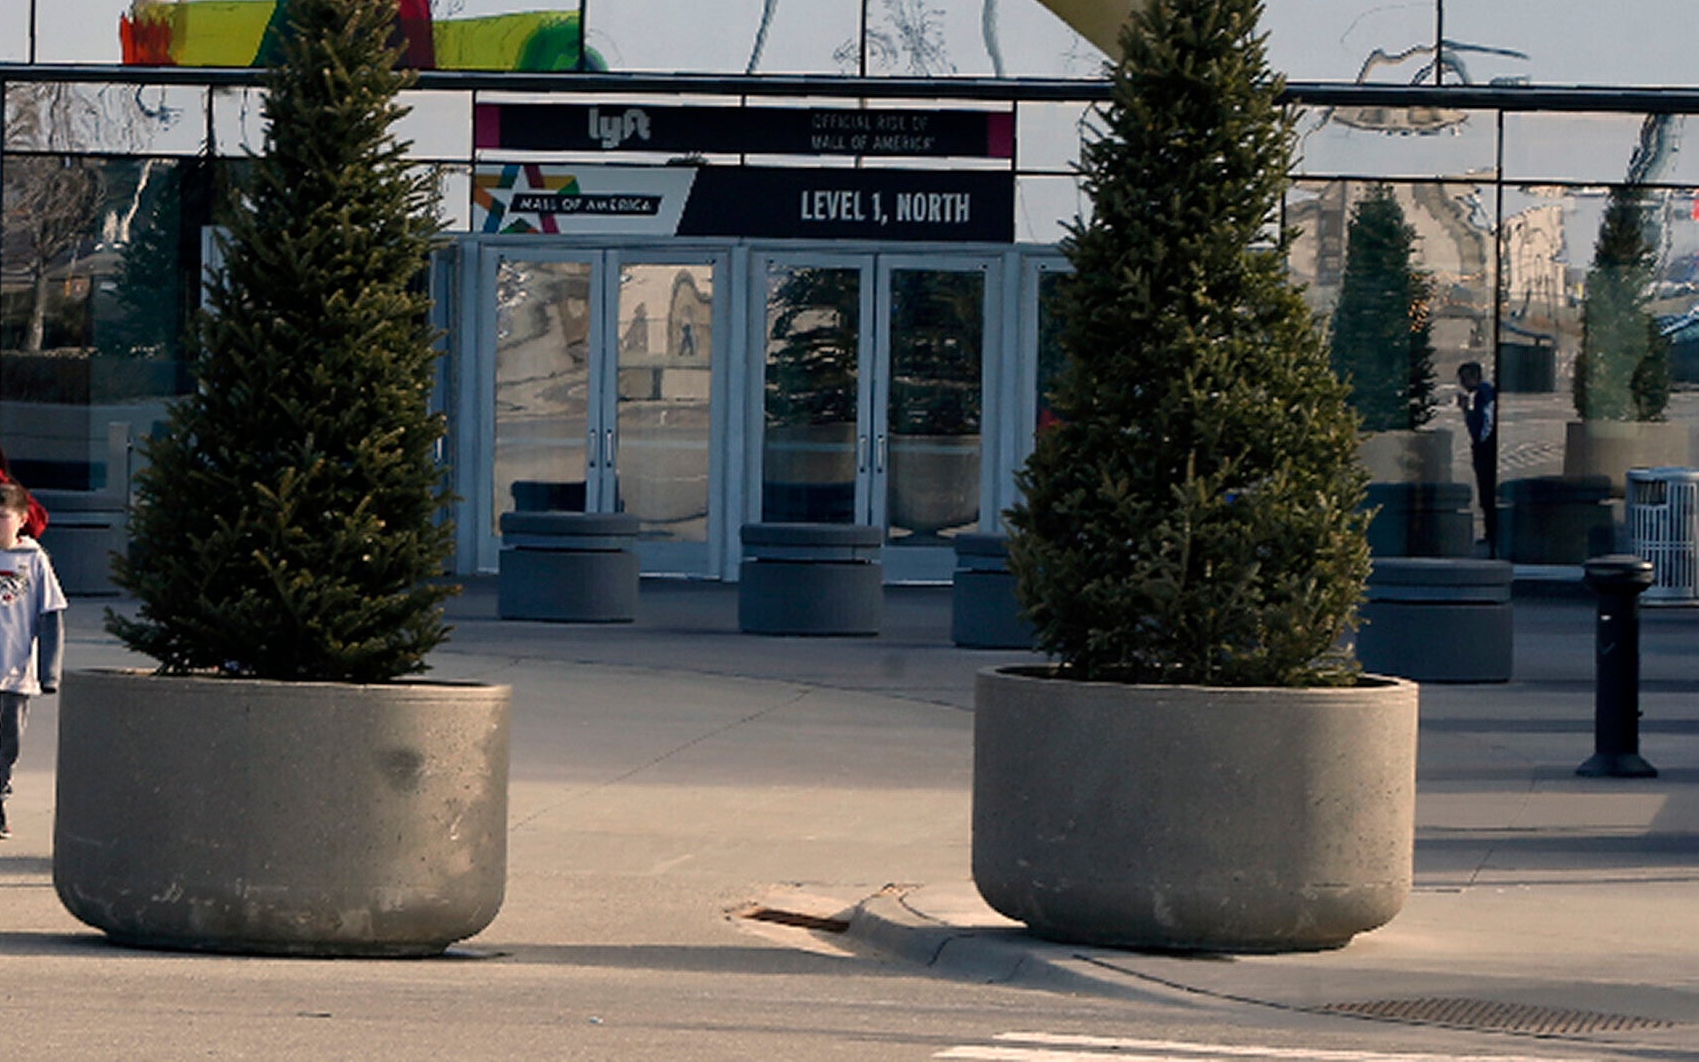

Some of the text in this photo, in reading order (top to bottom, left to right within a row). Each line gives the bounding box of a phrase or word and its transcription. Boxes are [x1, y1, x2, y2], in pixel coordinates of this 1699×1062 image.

[588, 107, 651, 149] lyft
[811, 134, 846, 150] MALL
[850, 135, 869, 151] OF
[519, 197, 652, 212] MALL OF AMERICA
[801, 190, 971, 226] LEVEL 1, NORTH
